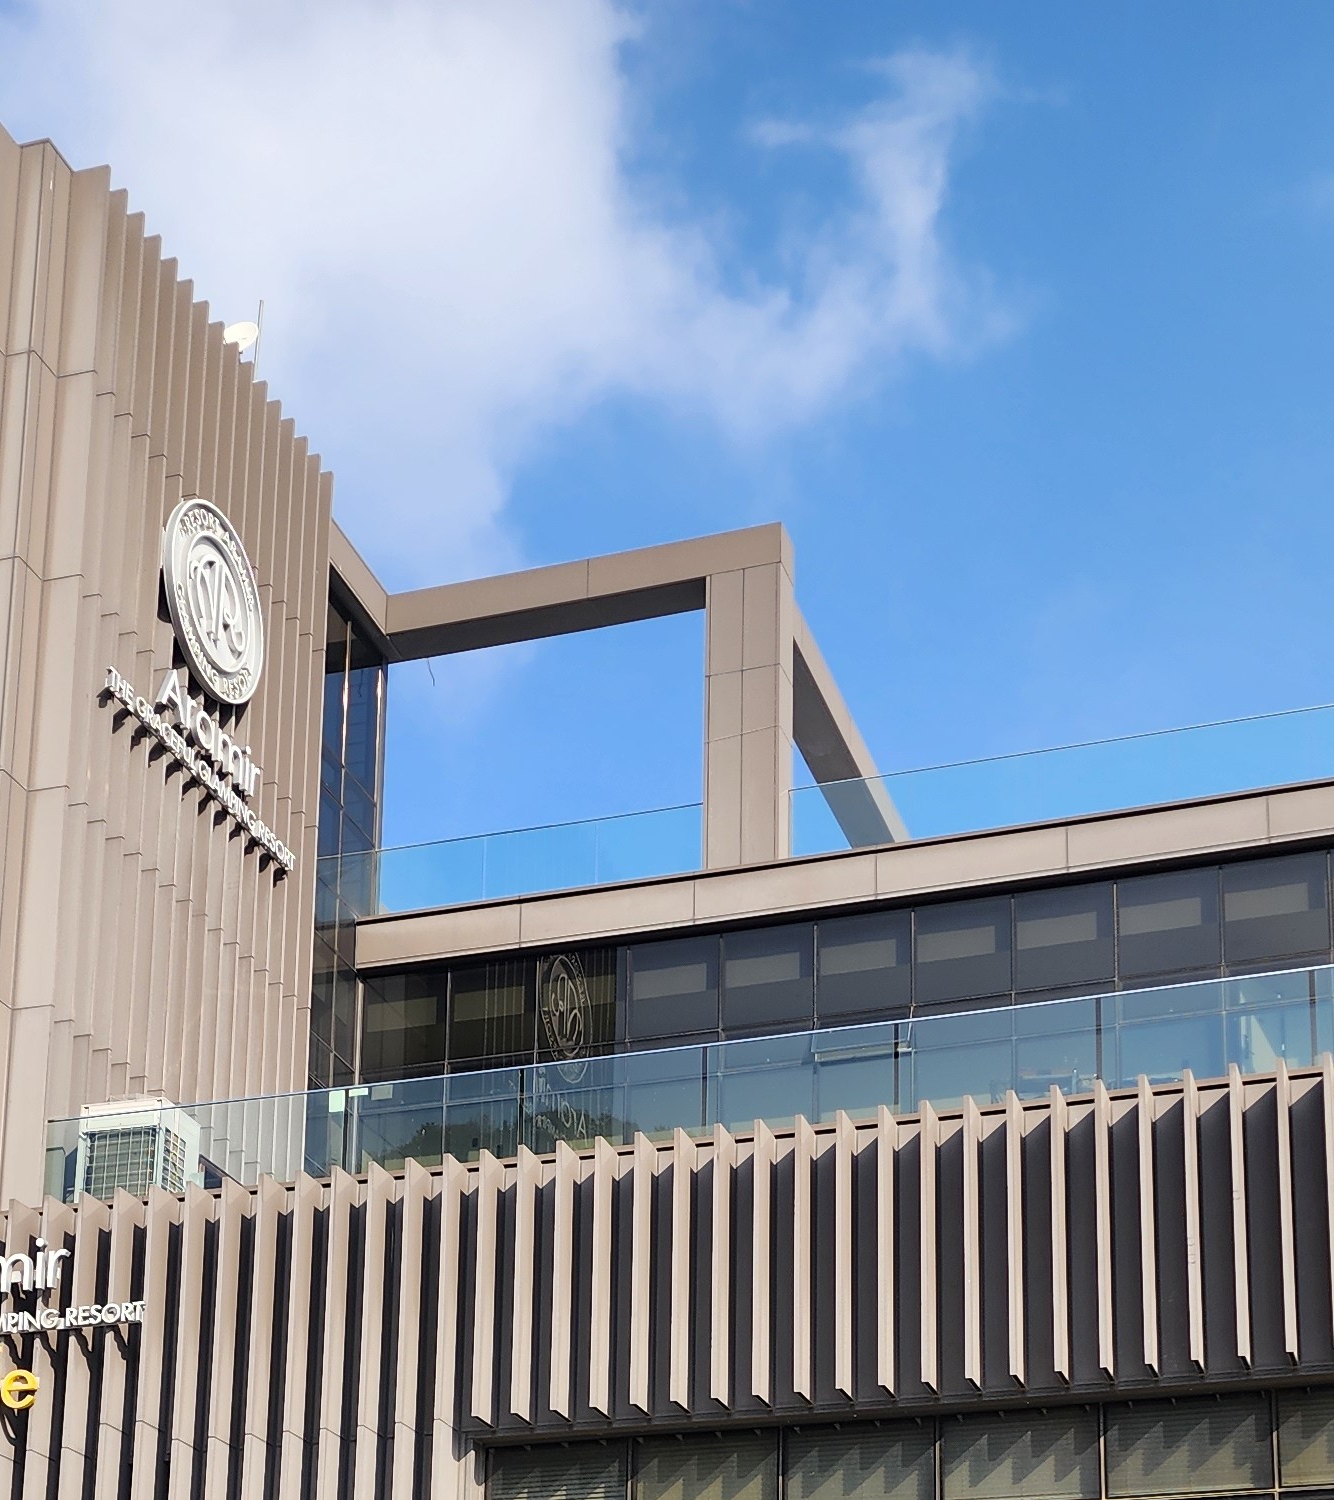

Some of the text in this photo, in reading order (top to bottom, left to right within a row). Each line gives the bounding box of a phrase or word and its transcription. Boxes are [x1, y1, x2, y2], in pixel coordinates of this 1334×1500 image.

[110, 665, 297, 871] THE GRACEFUL GLAMPING RESORT
[156, 668, 262, 798] Aramir
[64, 1299, 146, 1328] RESORT
